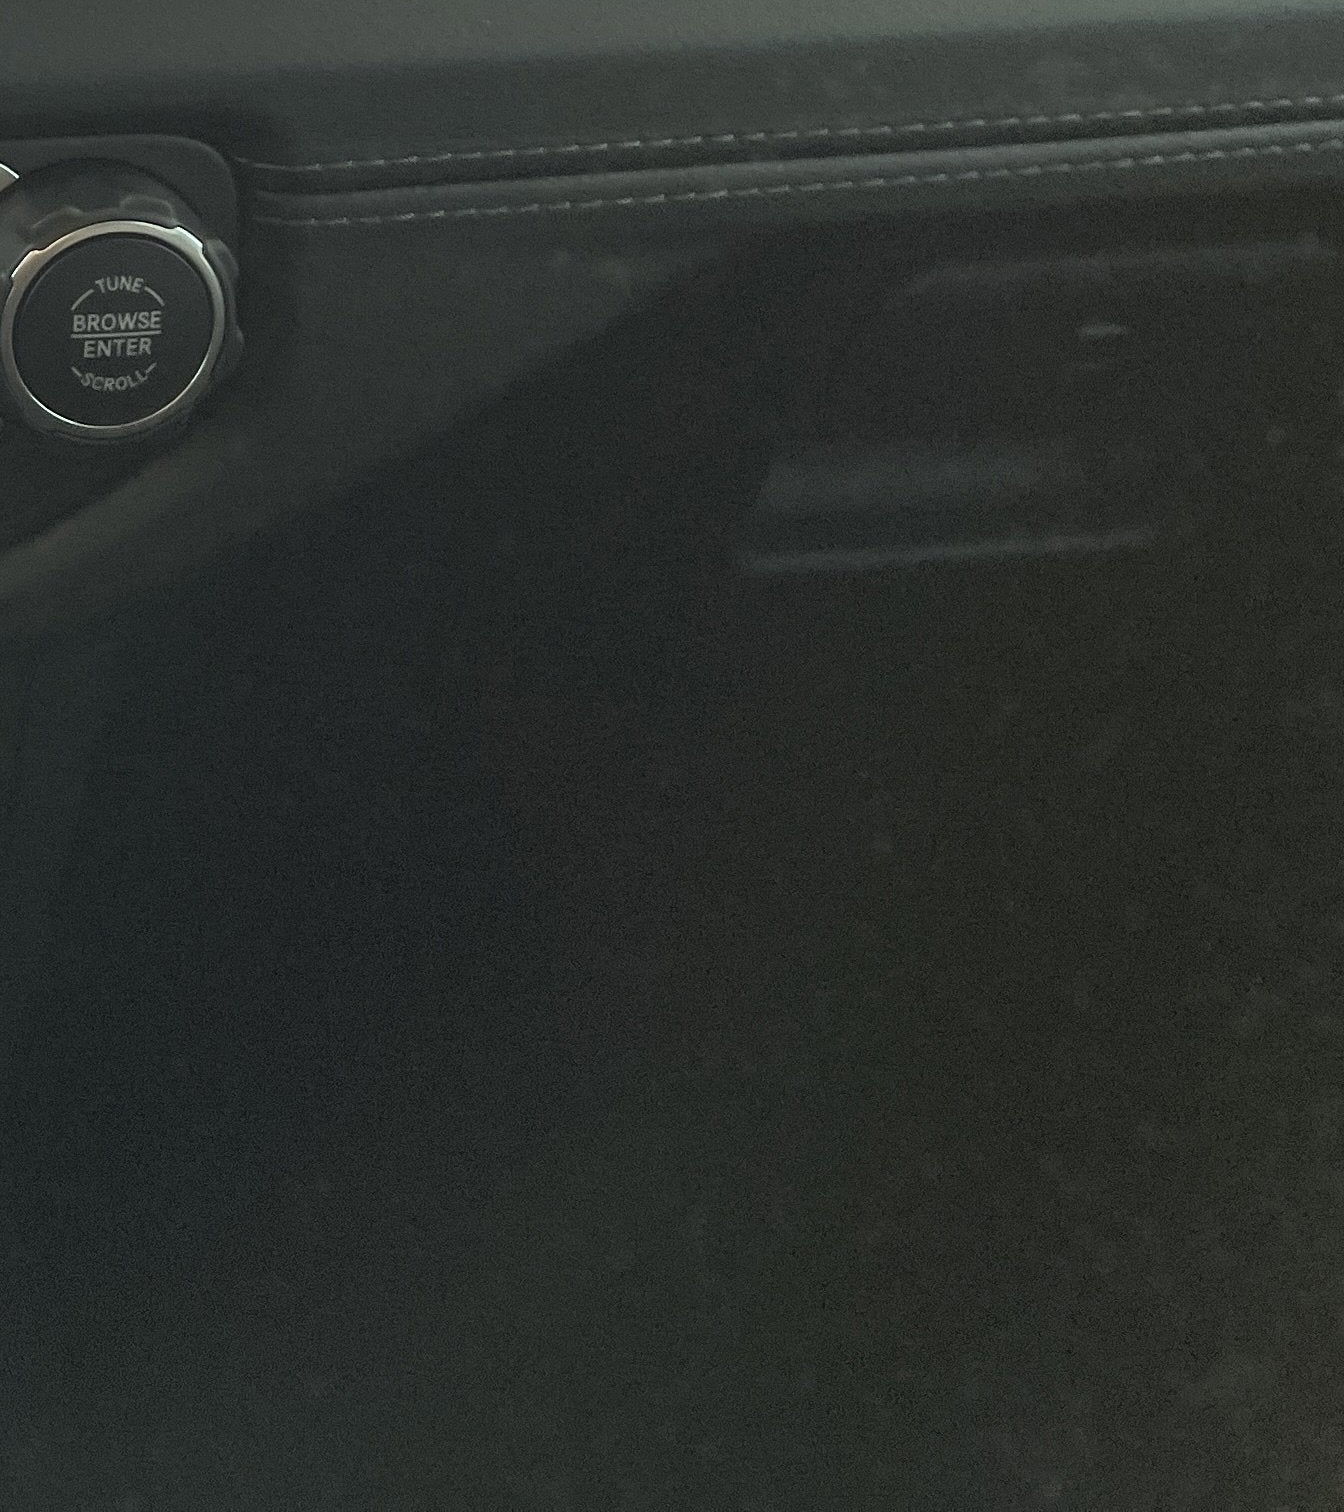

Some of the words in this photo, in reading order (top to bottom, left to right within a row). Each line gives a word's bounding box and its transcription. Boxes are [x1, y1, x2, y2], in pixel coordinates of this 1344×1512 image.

[94, 274, 145, 294] TUNE
[72, 310, 162, 333] BROWSE
[83, 338, 152, 359] ENTER
[80, 369, 149, 392] SCROLL
